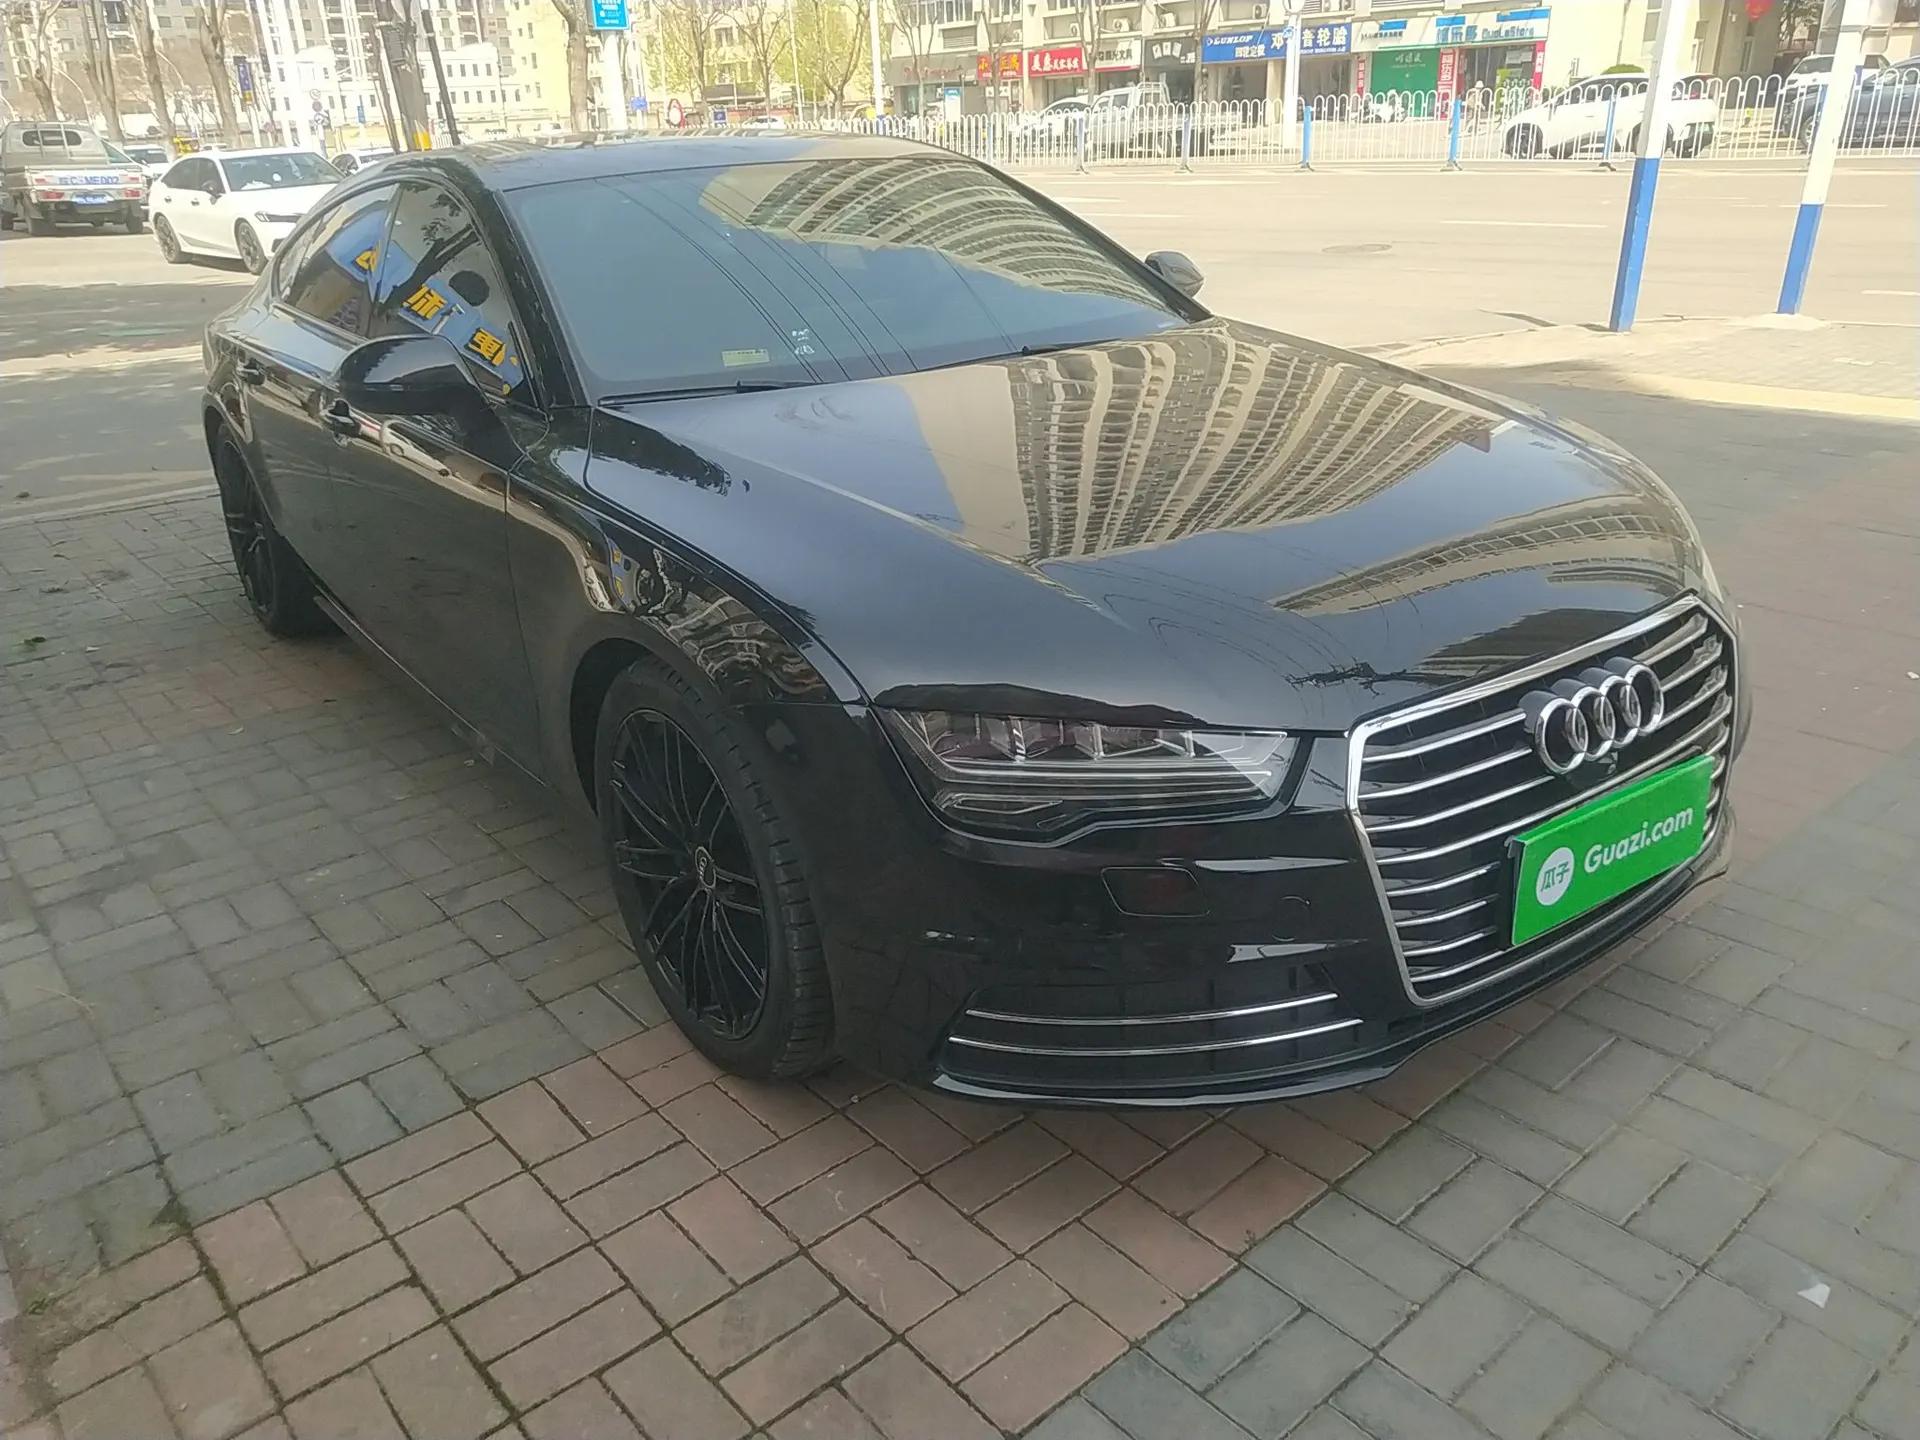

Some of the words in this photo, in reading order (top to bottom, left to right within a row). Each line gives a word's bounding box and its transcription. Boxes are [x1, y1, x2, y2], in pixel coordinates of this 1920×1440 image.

[1271, 26, 1348, 49] 邓普轮胎
[1584, 808, 1693, 873] Guazi.com
[1541, 861, 1570, 892] 瓜子
